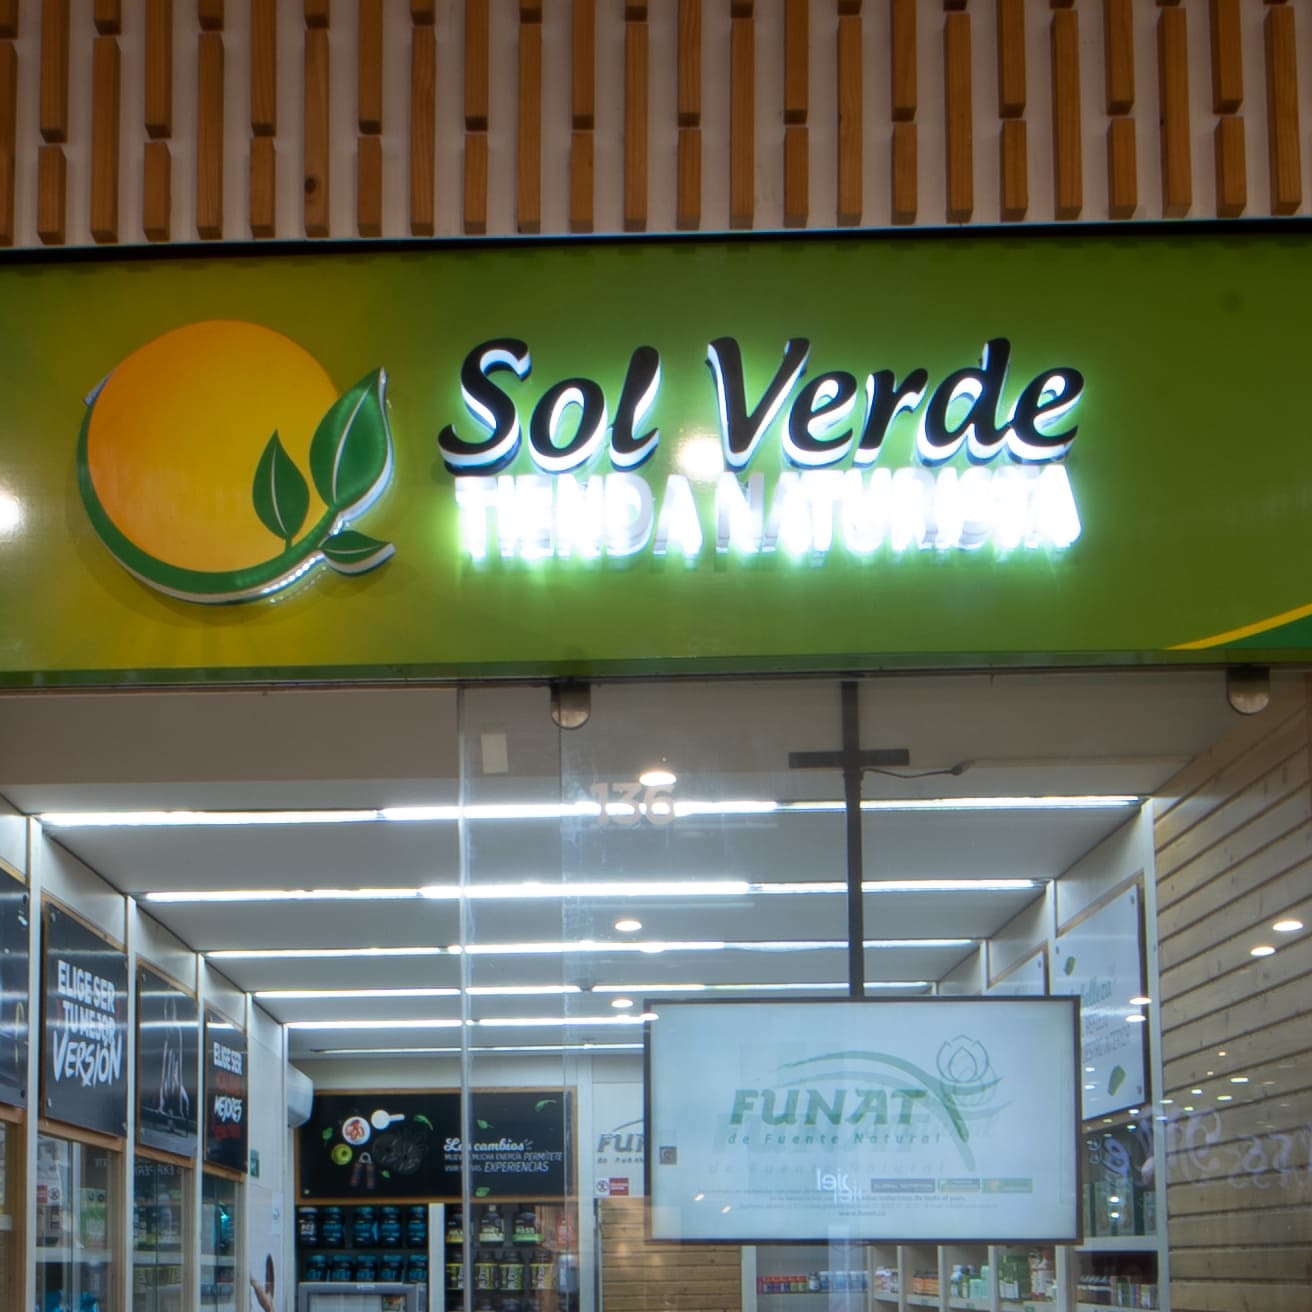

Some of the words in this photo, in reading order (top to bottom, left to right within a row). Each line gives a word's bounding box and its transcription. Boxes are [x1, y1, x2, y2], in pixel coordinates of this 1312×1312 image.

[438, 338, 661, 473] Sol
[706, 337, 1085, 472] Verde
[58, 959, 92, 1005] ELIGE
[93, 975, 115, 1014] SER
[730, 1088, 928, 1126] FUNAT
[474, 1137, 525, 1152] cambios
